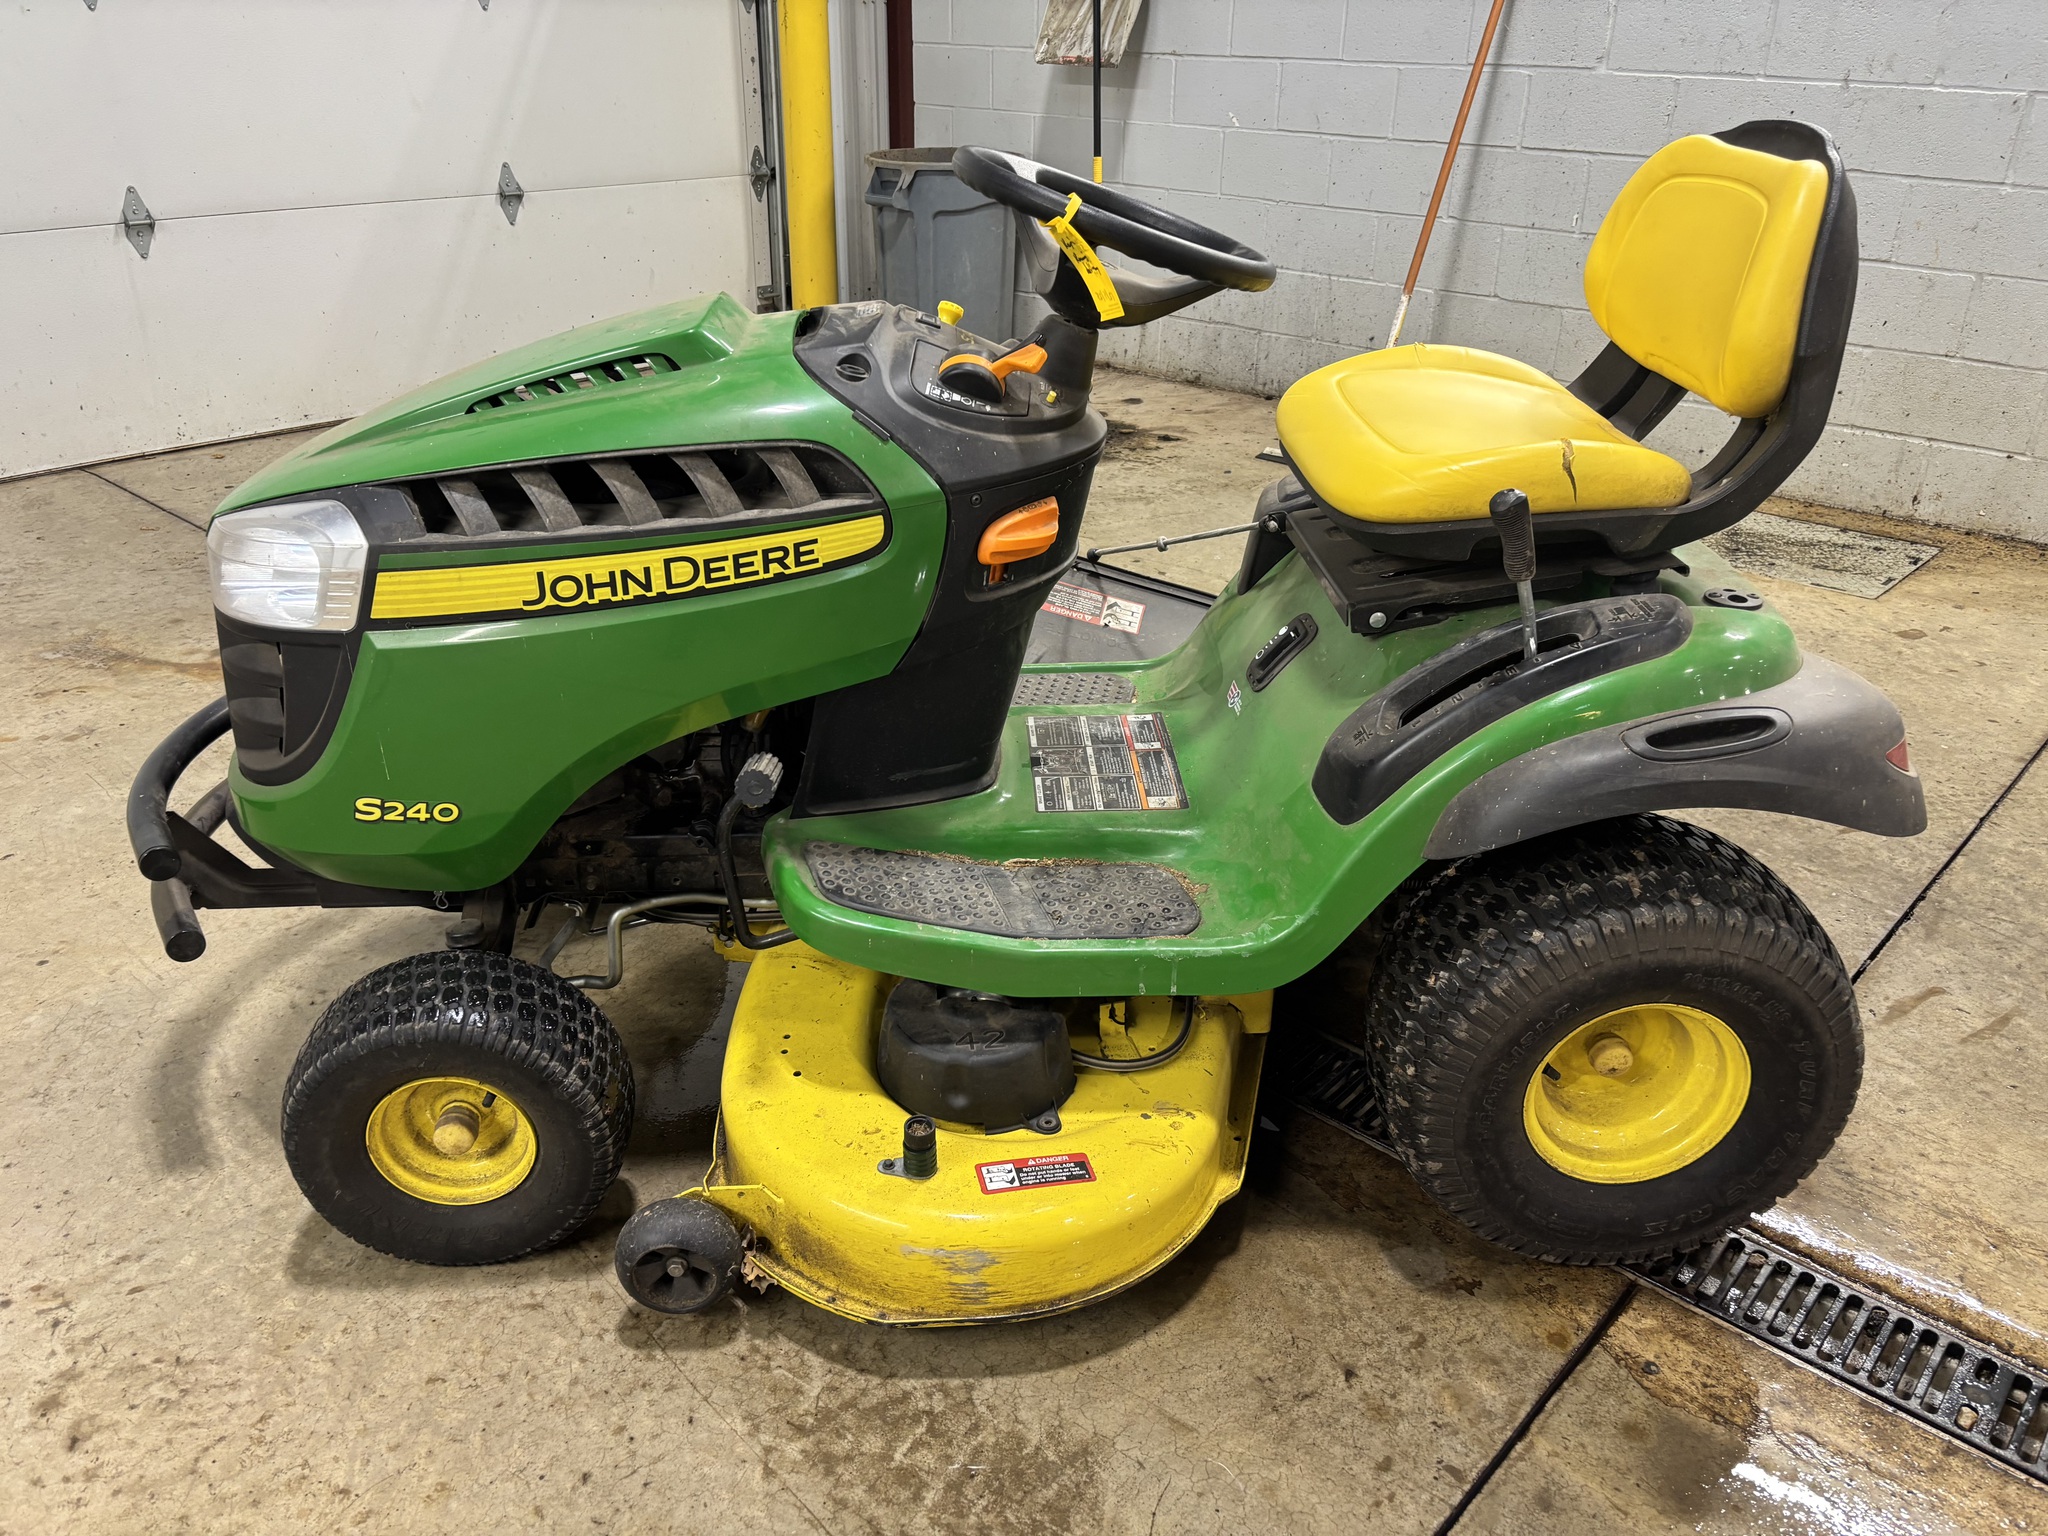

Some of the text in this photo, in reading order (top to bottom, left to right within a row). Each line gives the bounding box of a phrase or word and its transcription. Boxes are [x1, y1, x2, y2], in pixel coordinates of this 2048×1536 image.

[522, 538, 820, 607] JOHN DEERE
[1050, 605, 1083, 619] DANGER
[354, 796, 461, 823] S240
[954, 1030, 1008, 1051] 42
[1022, 1164, 1054, 1172] ROTATING
[1036, 1156, 1069, 1164] DANGER
